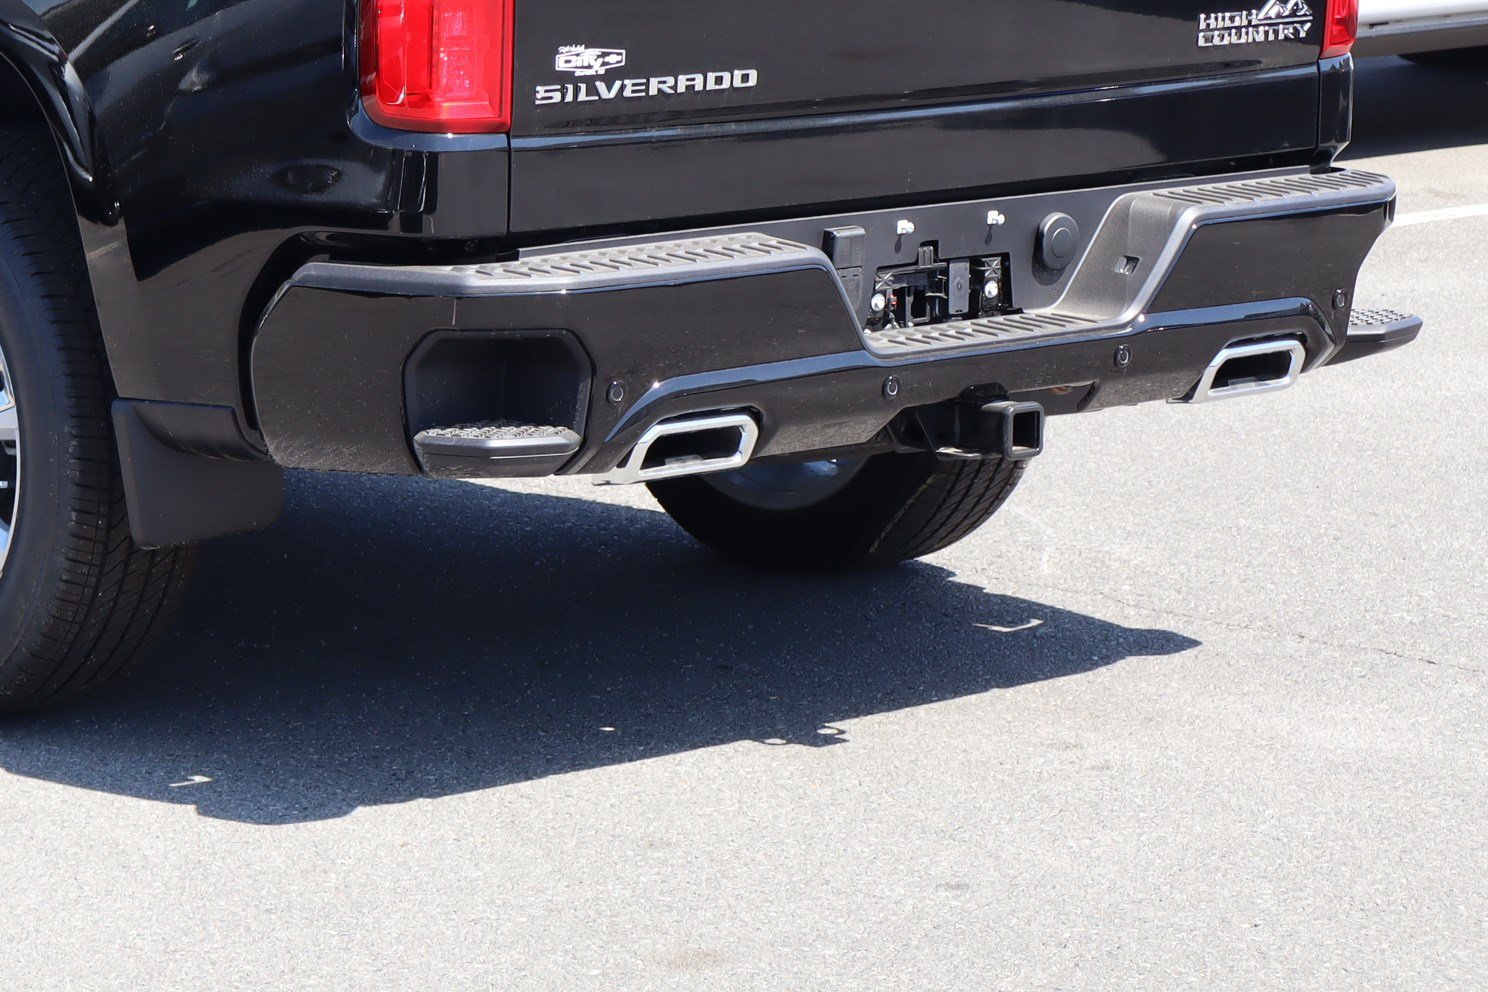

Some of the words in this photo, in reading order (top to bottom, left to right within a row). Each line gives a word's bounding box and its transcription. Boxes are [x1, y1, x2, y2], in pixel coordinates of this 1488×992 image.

[1199, 9, 1259, 29] HIGH
[1198, 22, 1312, 46] COUNTRY
[535, 68, 758, 105] SILVERADO
